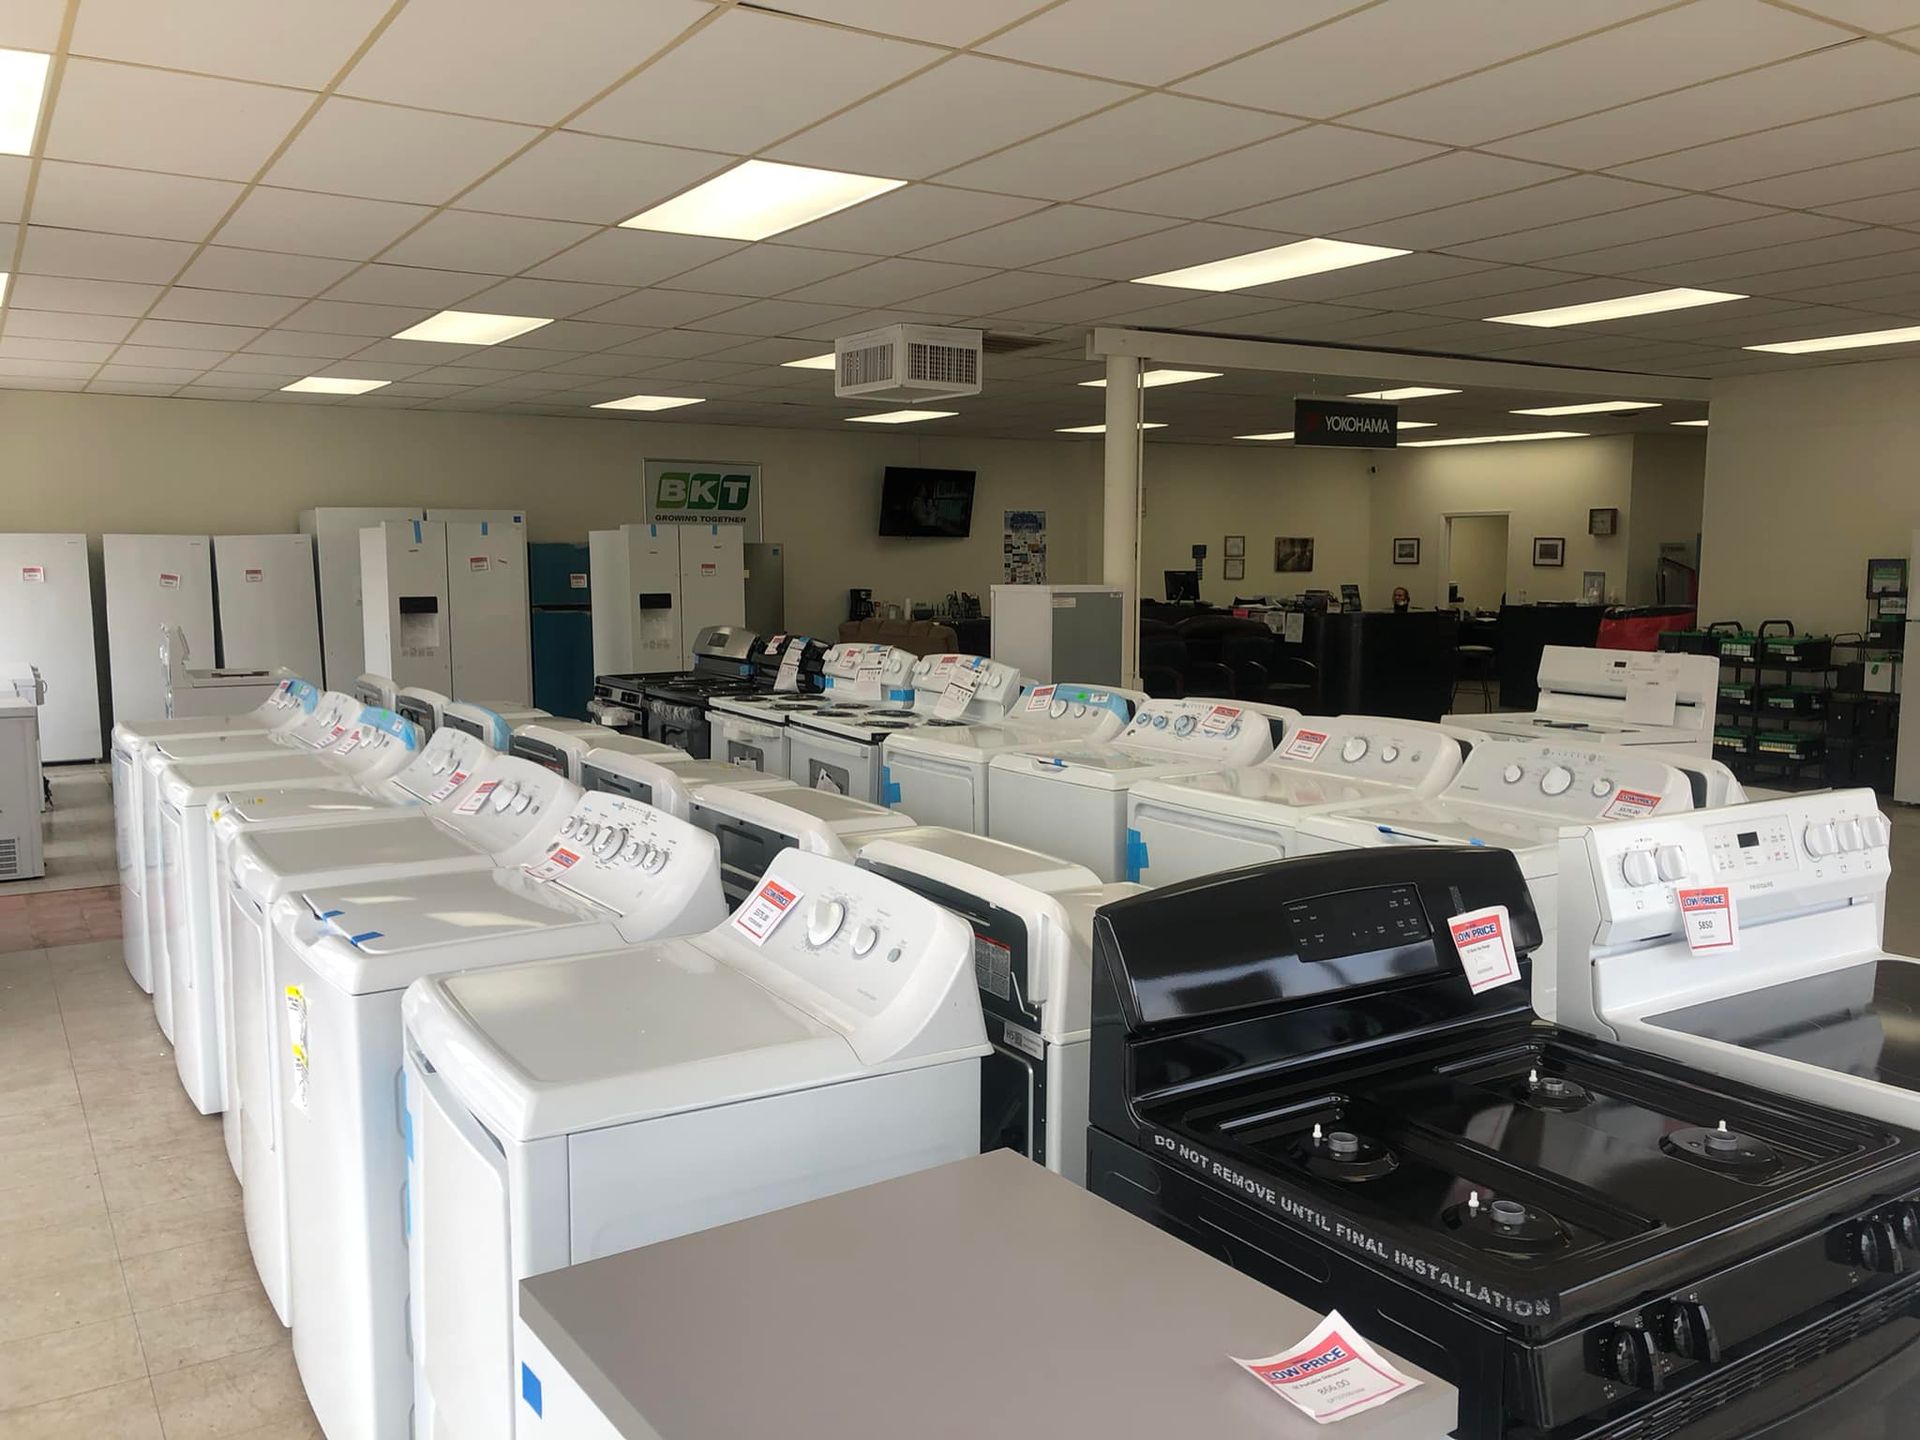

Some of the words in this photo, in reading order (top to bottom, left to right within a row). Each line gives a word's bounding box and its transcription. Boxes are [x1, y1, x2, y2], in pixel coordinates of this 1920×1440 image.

[1325, 416, 1390, 433] YOKOHAMA
[658, 476, 749, 506] BKT
[655, 514, 698, 523] GROWING
[700, 515, 747, 524] TOGETHER
[1682, 897, 1699, 907] LOW
[1700, 895, 1725, 906] PRICE
[1472, 923, 1497, 938] PRICE
[1154, 1134, 1175, 1151] DO
[1179, 1144, 1209, 1169] NOT
[1212, 1163, 1276, 1205] REMOVE
[1280, 1197, 1331, 1233] UNTIL
[1336, 1223, 1389, 1260] FINAL
[1394, 1250, 1551, 1316] INSTALLATION
[1264, 1366, 1301, 1381] LOW
[1300, 1347, 1346, 1372] PRICE
